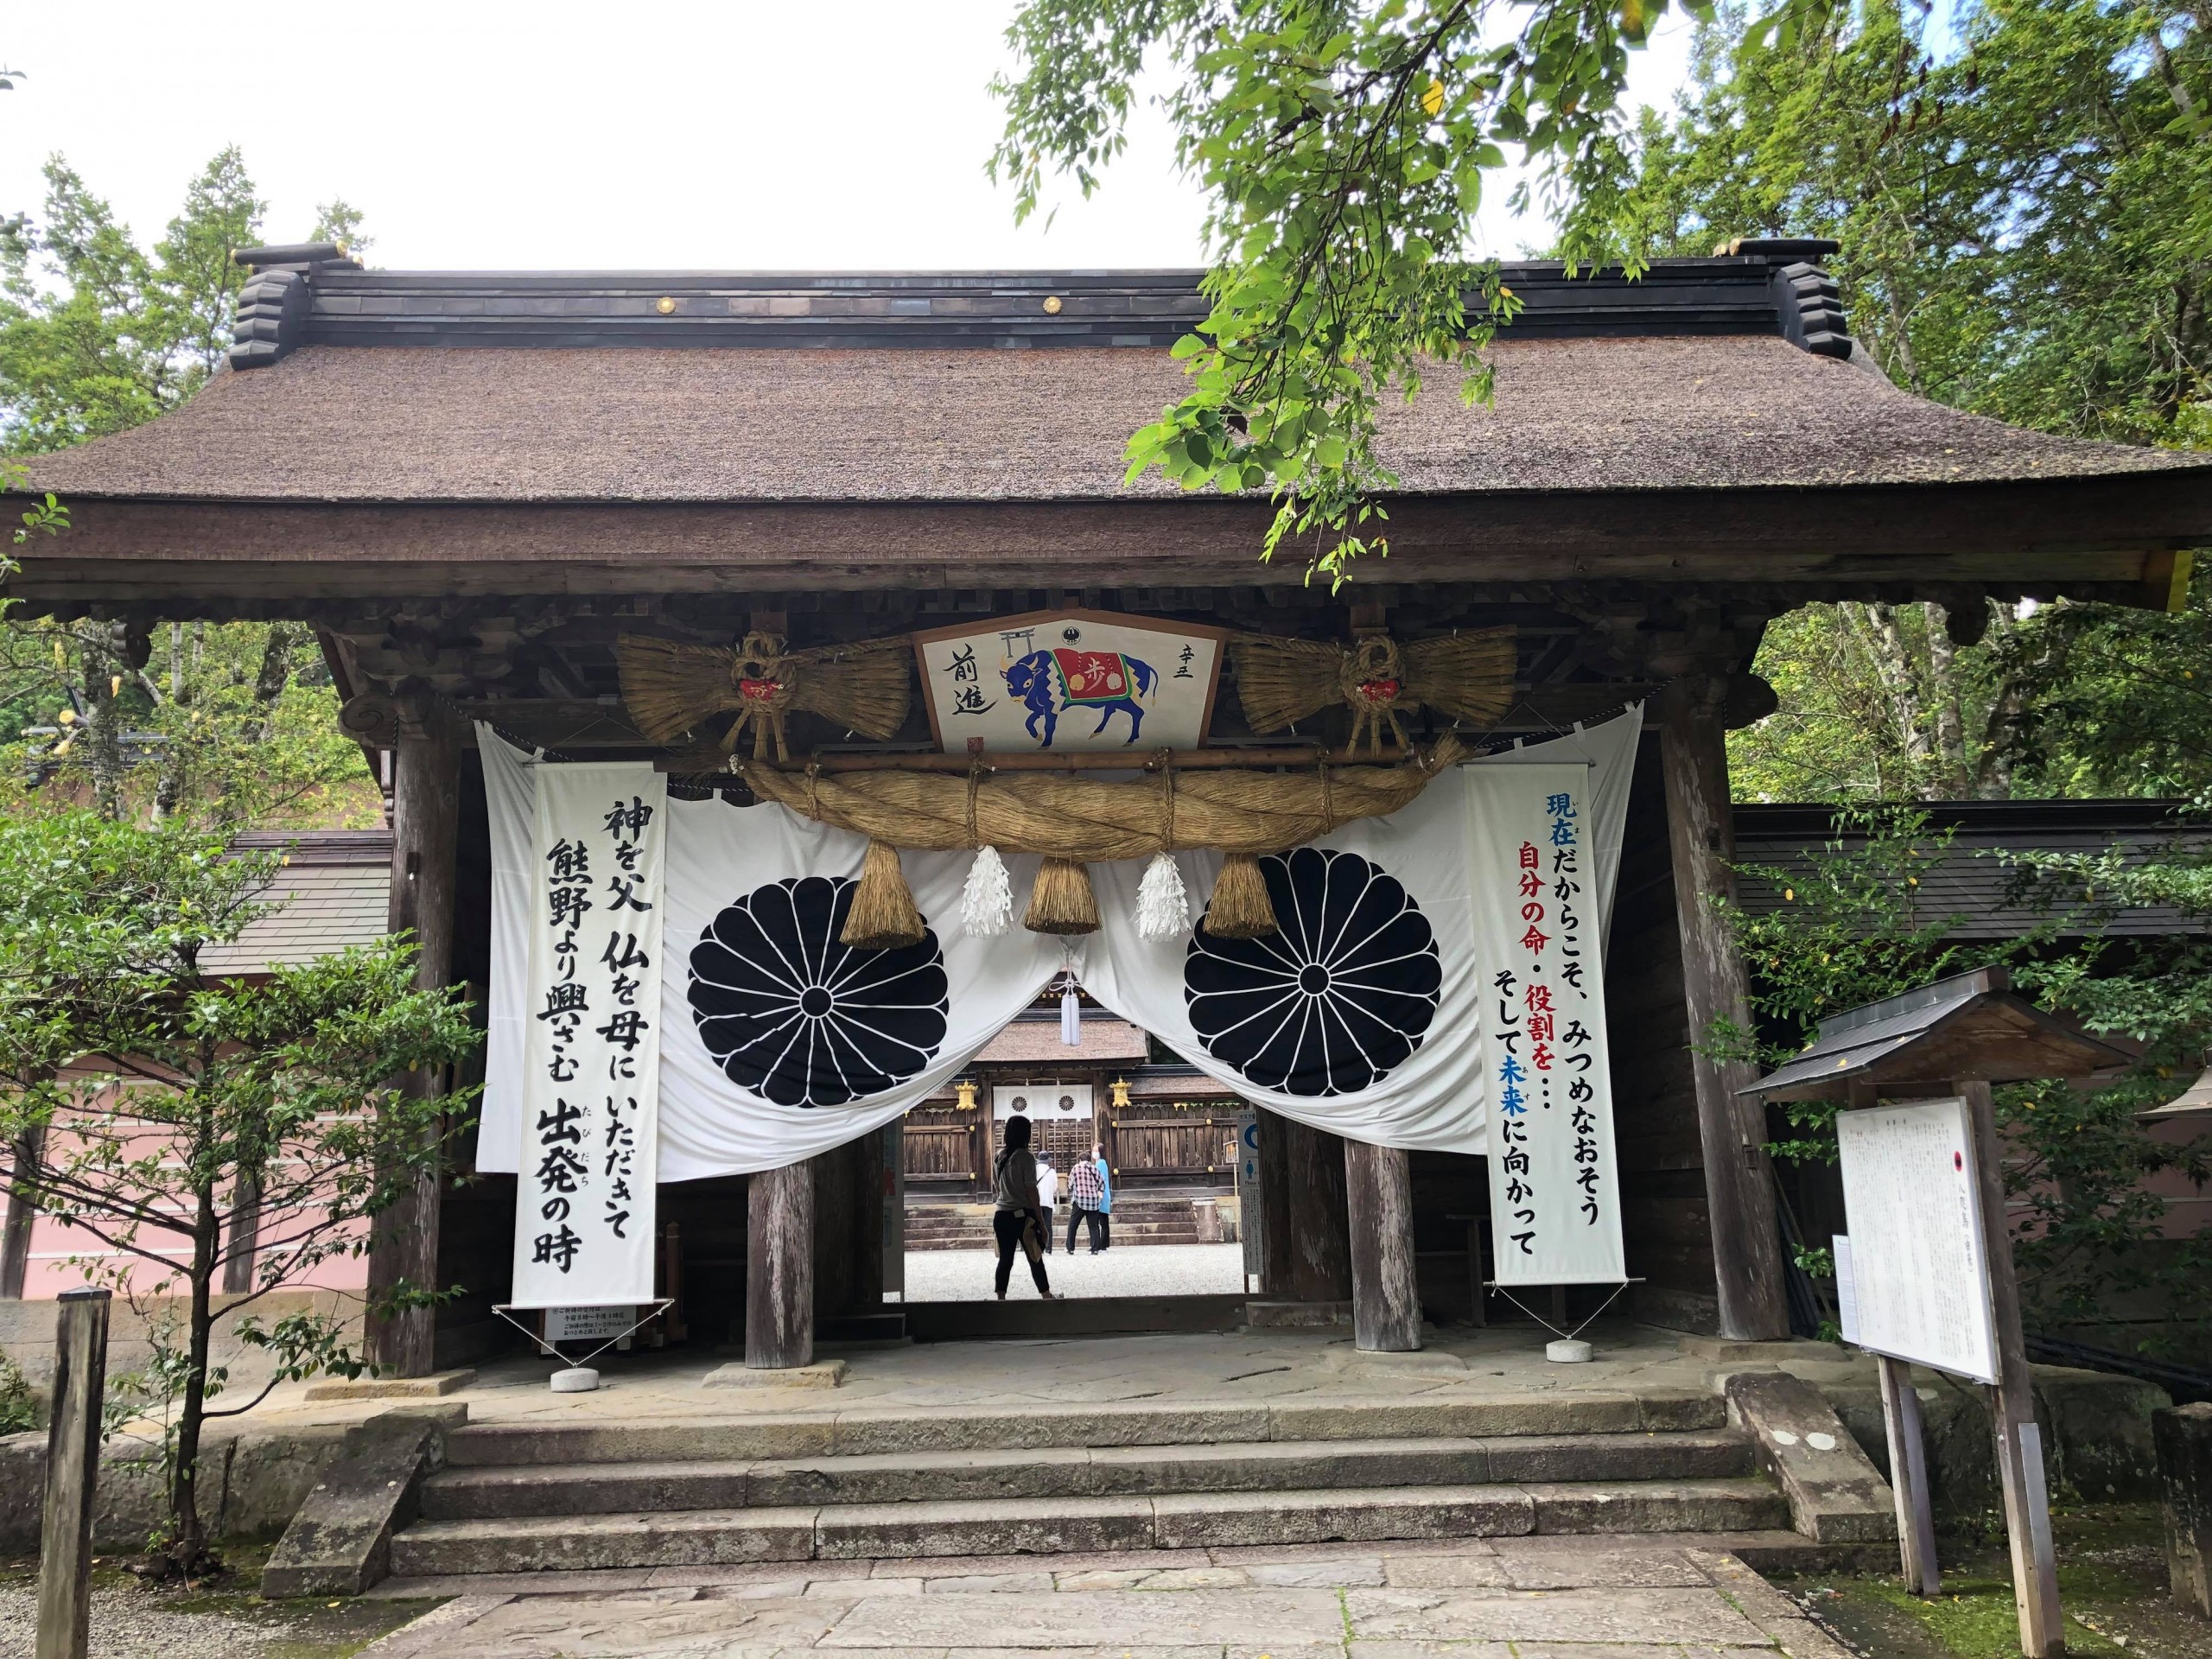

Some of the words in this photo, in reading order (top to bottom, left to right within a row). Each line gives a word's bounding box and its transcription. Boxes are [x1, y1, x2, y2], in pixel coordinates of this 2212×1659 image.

[942, 643, 999, 715] 前進
[1084, 657, 1107, 692] 歩
[1494, 970, 1535, 1255] そして未来に向かって
